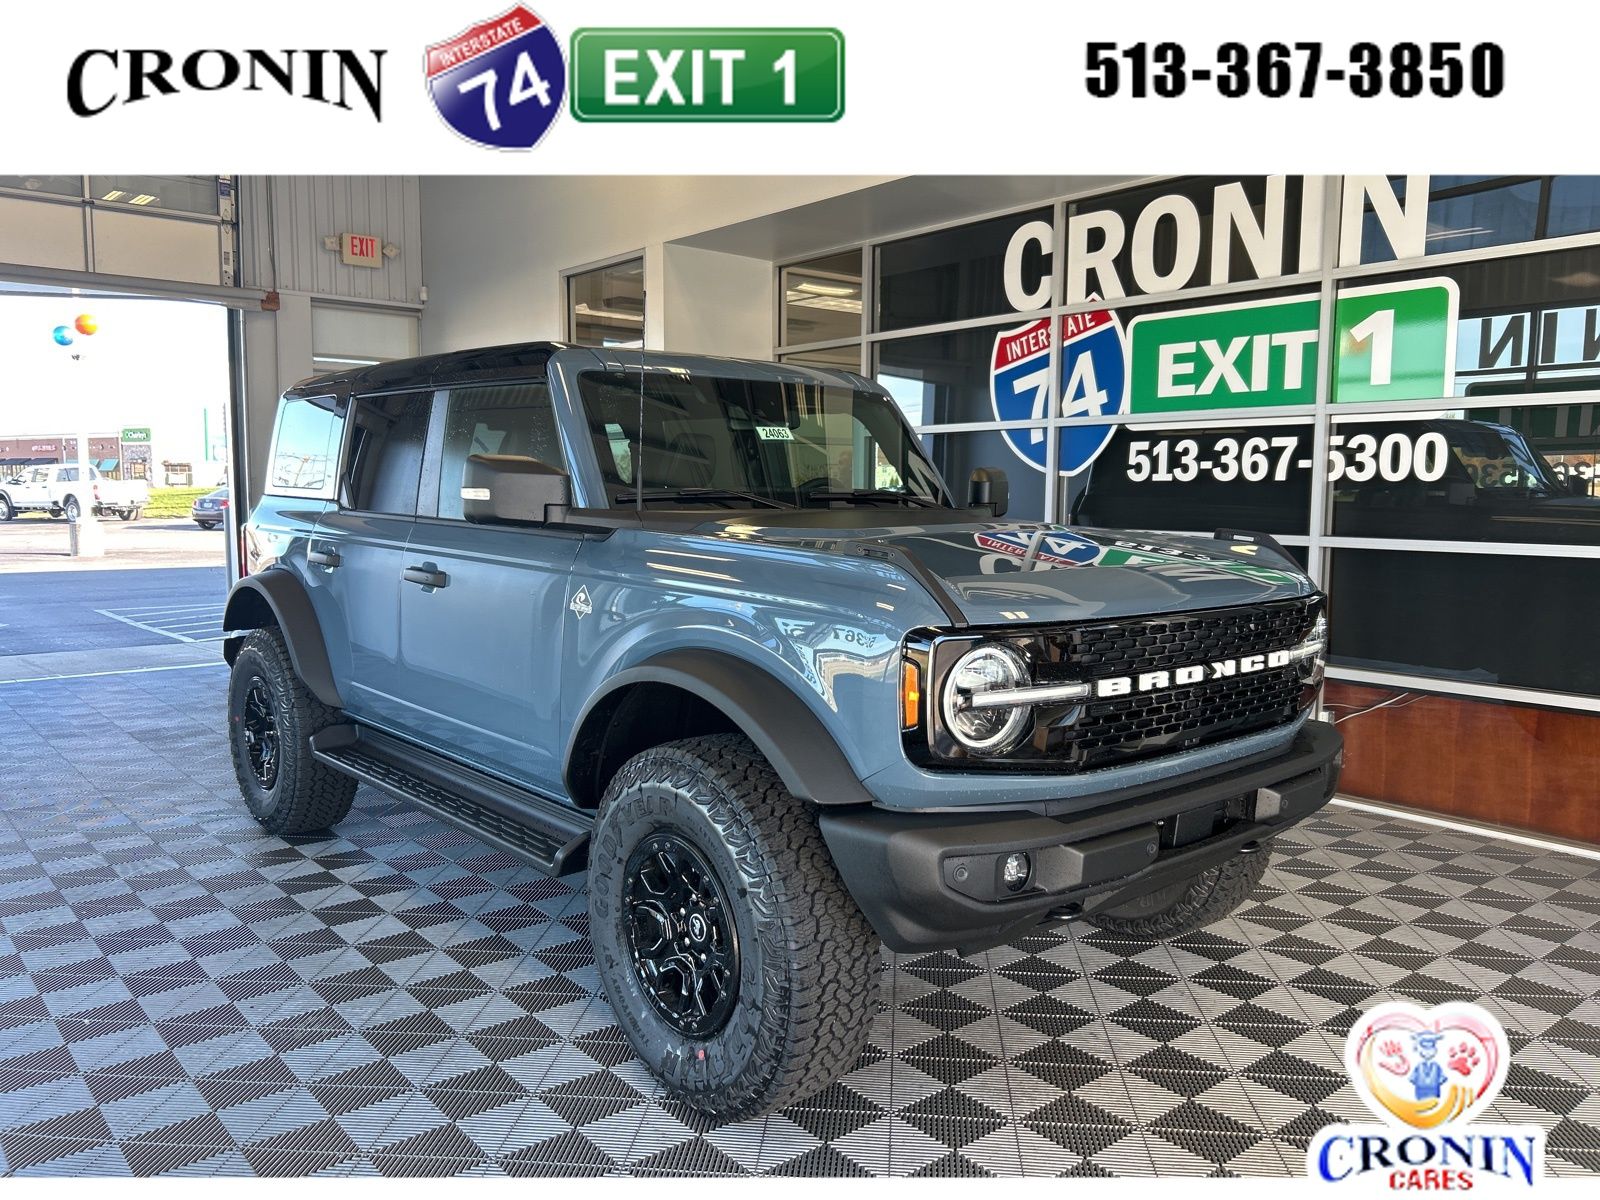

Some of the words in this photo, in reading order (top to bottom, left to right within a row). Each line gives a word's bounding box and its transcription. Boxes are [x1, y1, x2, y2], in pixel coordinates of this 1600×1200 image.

[351, 236, 375, 258] EXIT
[1004, 174, 1428, 311] CRONIN
[1006, 313, 1096, 362] INTERATE
[1157, 329, 1319, 399] EXIT
[1350, 309, 1395, 386] 1
[1012, 350, 1108, 445] 74
[762, 428, 789, 438] 24063
[1126, 432, 1448, 482] 513-367-5300
[1098, 650, 1290, 697] BRONCO
